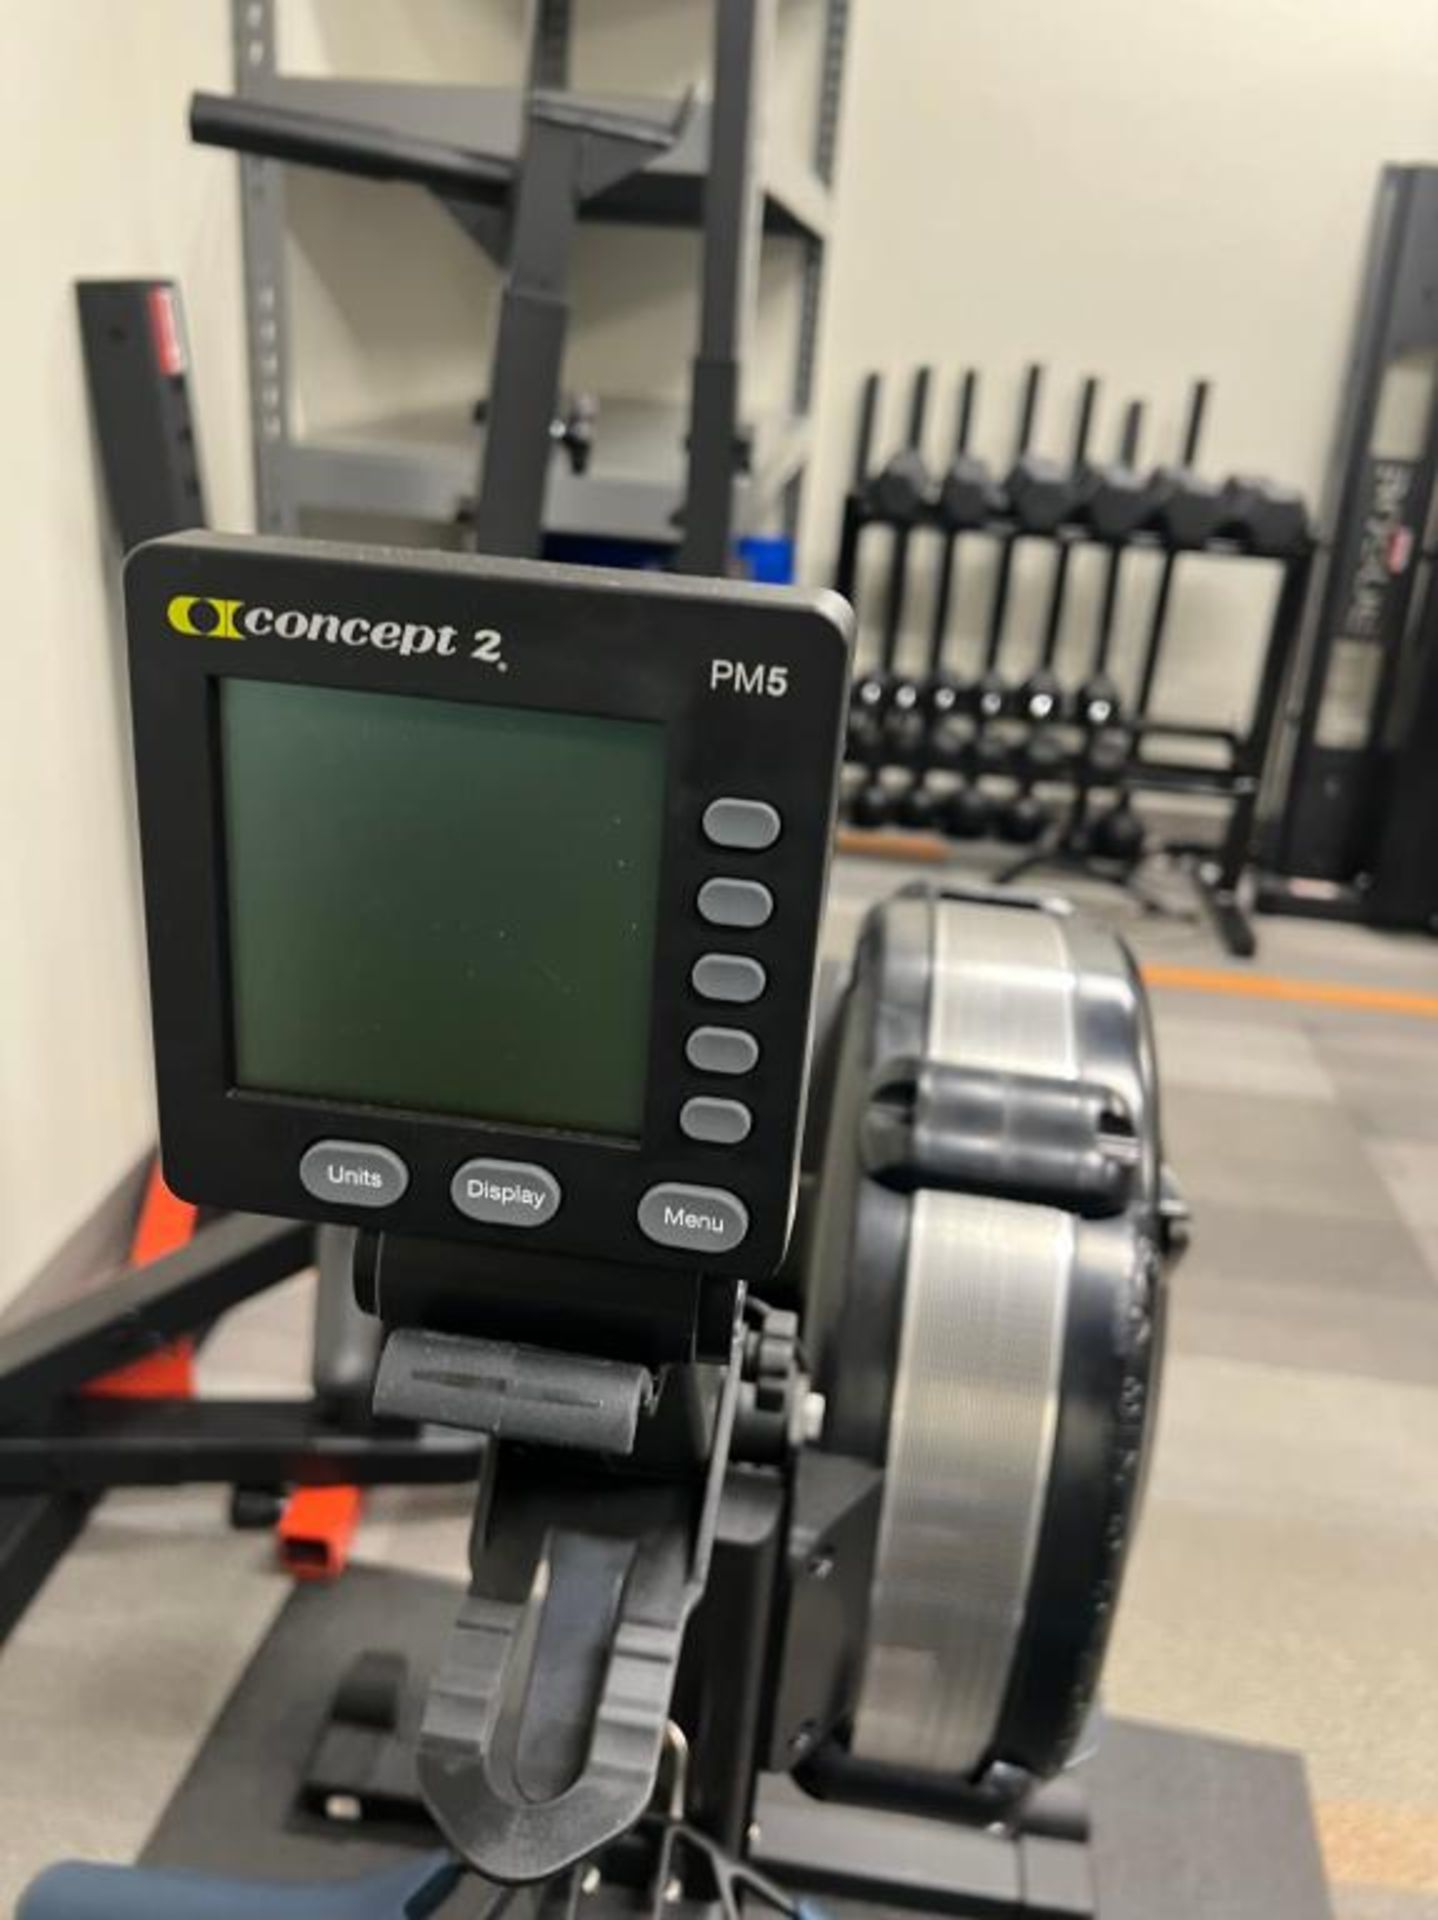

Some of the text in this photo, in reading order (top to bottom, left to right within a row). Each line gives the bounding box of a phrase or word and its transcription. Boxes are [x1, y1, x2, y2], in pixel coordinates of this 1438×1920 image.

[246, 606, 458, 656] concept
[710, 659, 788, 698] PM5
[327, 1164, 384, 1190] Units
[467, 1178, 546, 1212] Display
[664, 1206, 725, 1234] Menu
